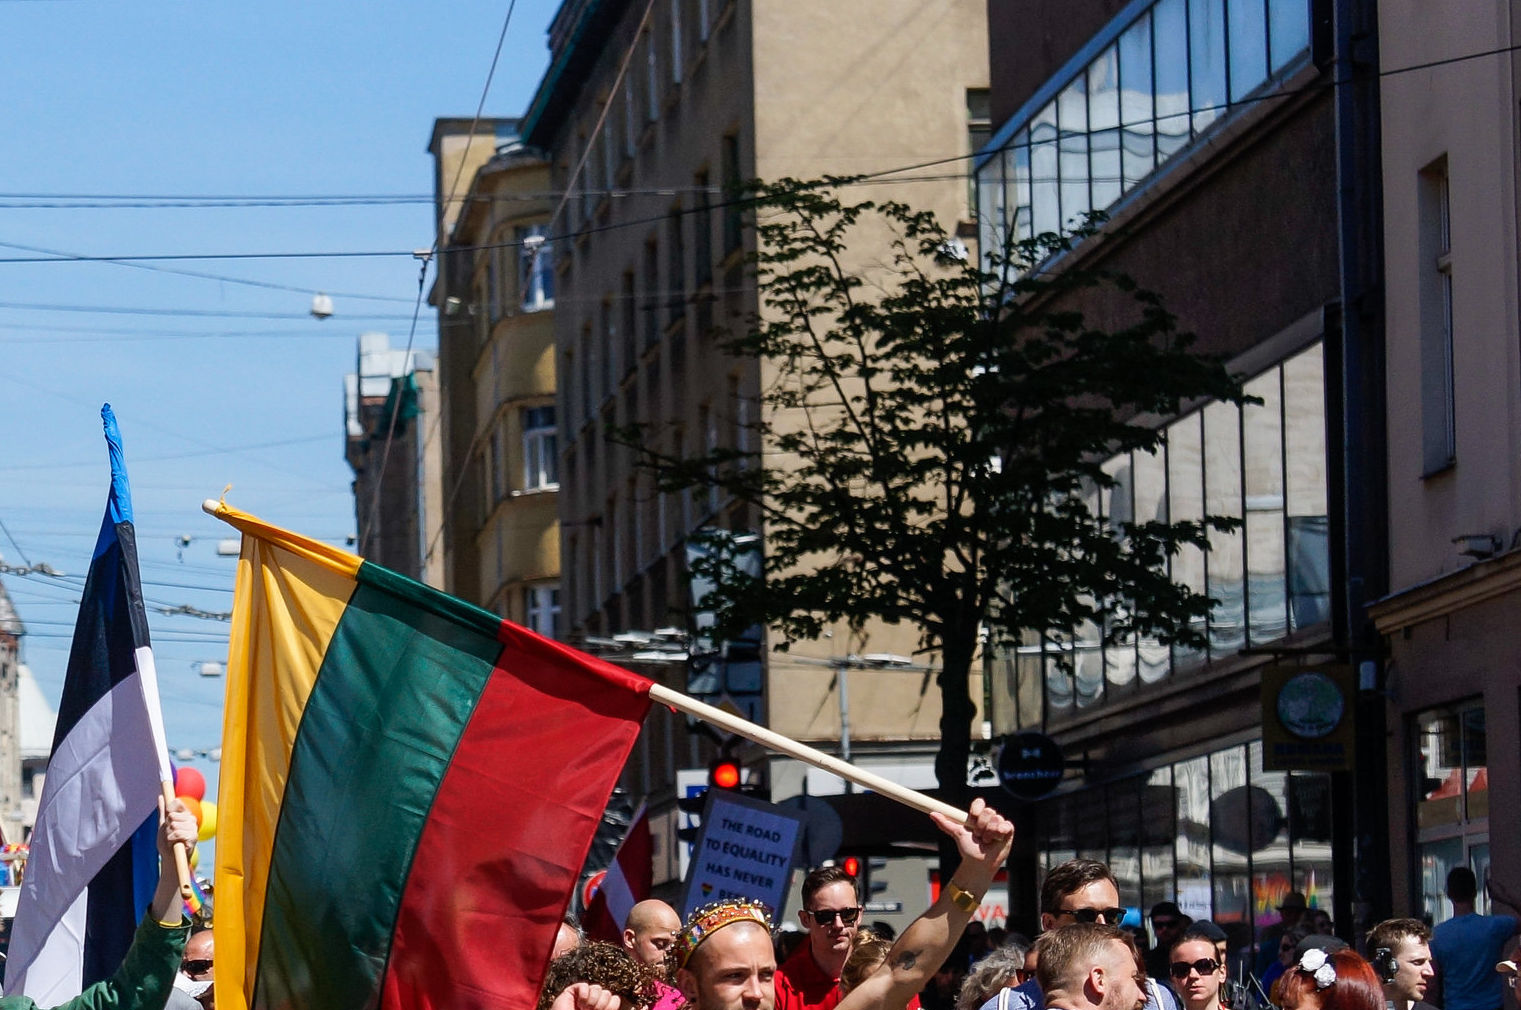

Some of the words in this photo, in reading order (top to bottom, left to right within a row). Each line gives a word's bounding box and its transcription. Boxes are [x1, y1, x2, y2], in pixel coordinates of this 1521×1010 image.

[722, 819, 743, 833] THE
[746, 825, 781, 842] ROAD
[705, 837, 721, 851] TO
[723, 842, 787, 867] EQUALITY
[707, 863, 730, 877] HAS
[733, 870, 774, 888] NEVER
